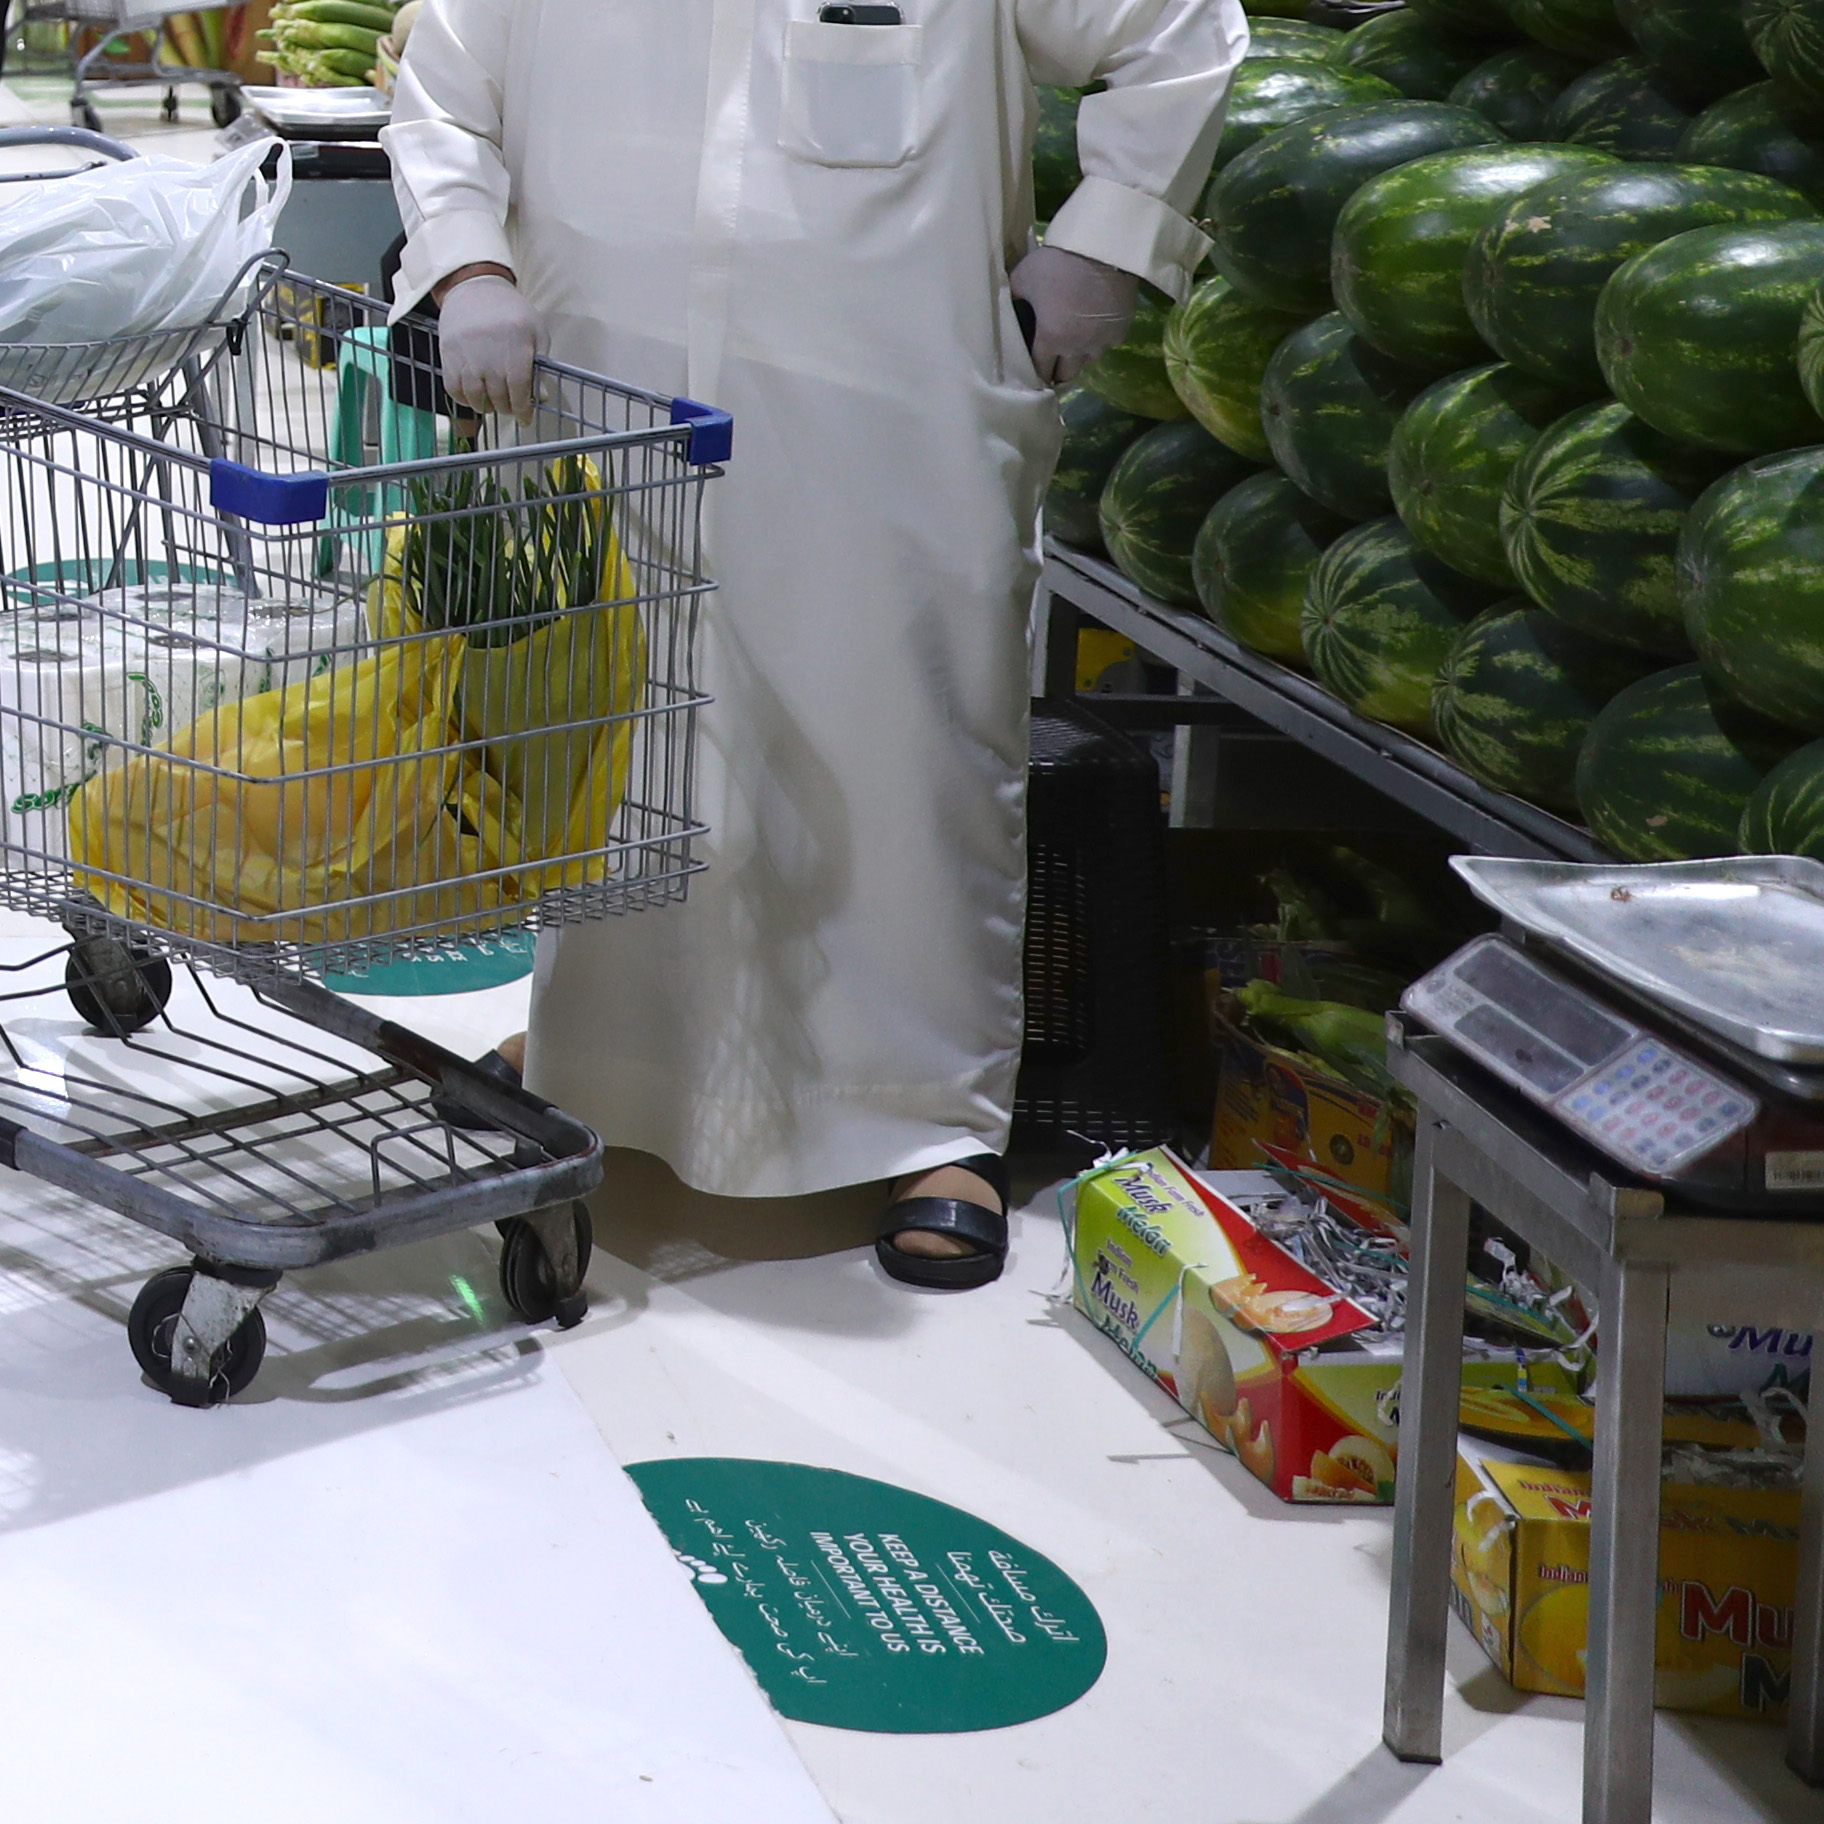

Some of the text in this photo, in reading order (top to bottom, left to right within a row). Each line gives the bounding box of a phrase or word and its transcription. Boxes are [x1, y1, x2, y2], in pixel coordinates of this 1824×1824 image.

[1114, 1175, 1175, 1215] Musk
[1117, 1205, 1172, 1257] Melon
[1090, 1272, 1140, 1329] Musk
[1730, 1324, 1814, 1357] Mu
[809, 1531, 911, 1653] IMPORTANT TO US
[843, 1532, 947, 1655] YOUR HEALTH IS
[877, 1533, 985, 1656] KEEP A DISTANCE
[946, 1550, 1027, 1644] صحتك تهمنا
[987, 1549, 1081, 1642] اترك مسافة
[1680, 1580, 1794, 1648] Mu
